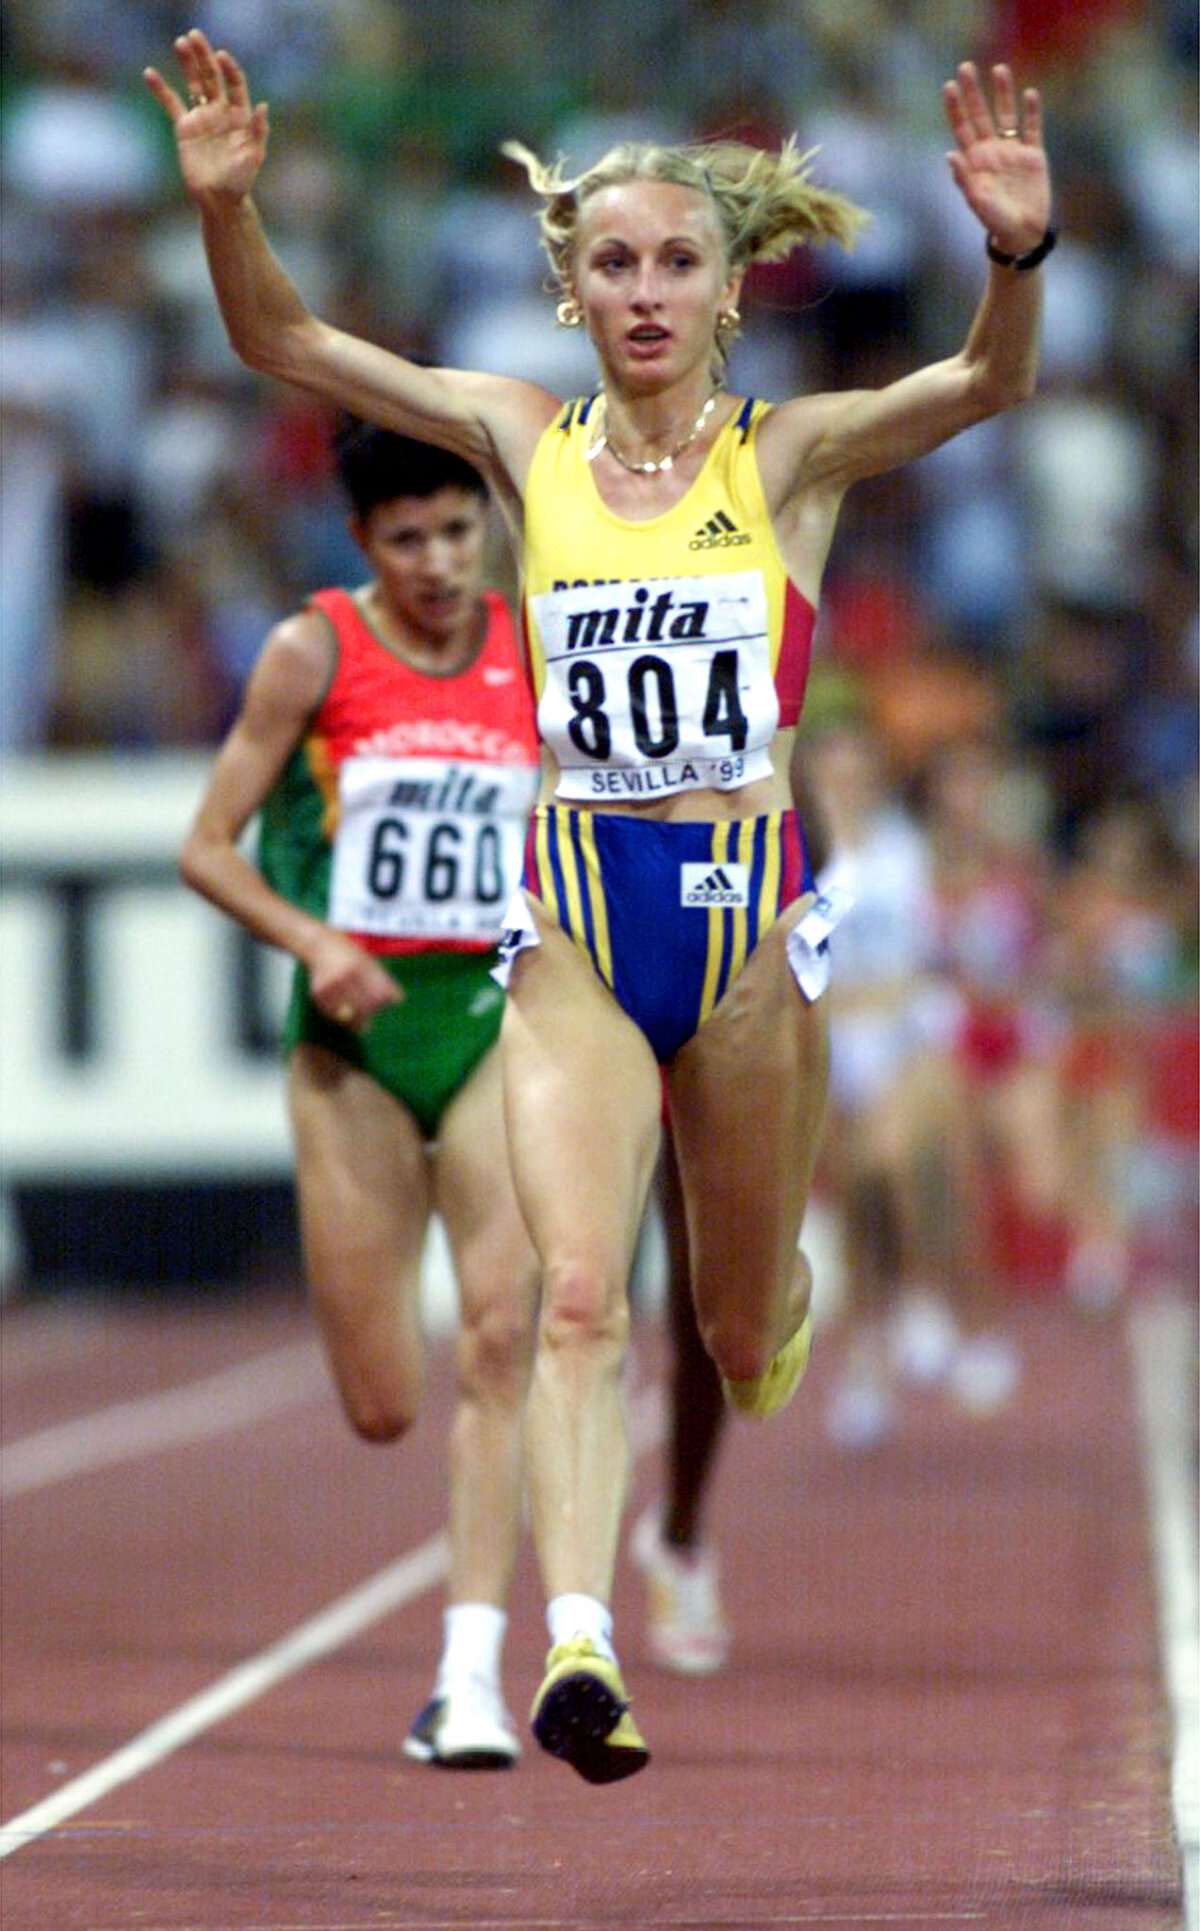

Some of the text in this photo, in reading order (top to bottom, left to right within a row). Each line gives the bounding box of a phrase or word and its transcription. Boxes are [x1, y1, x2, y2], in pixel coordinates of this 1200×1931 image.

[688, 531, 752, 551] adidas
[566, 587, 709, 649] mita
[567, 649, 749, 761] 804
[591, 763, 698, 793] SEVILLA
[368, 817, 506, 904] 660
[686, 889, 743, 904] adidas
